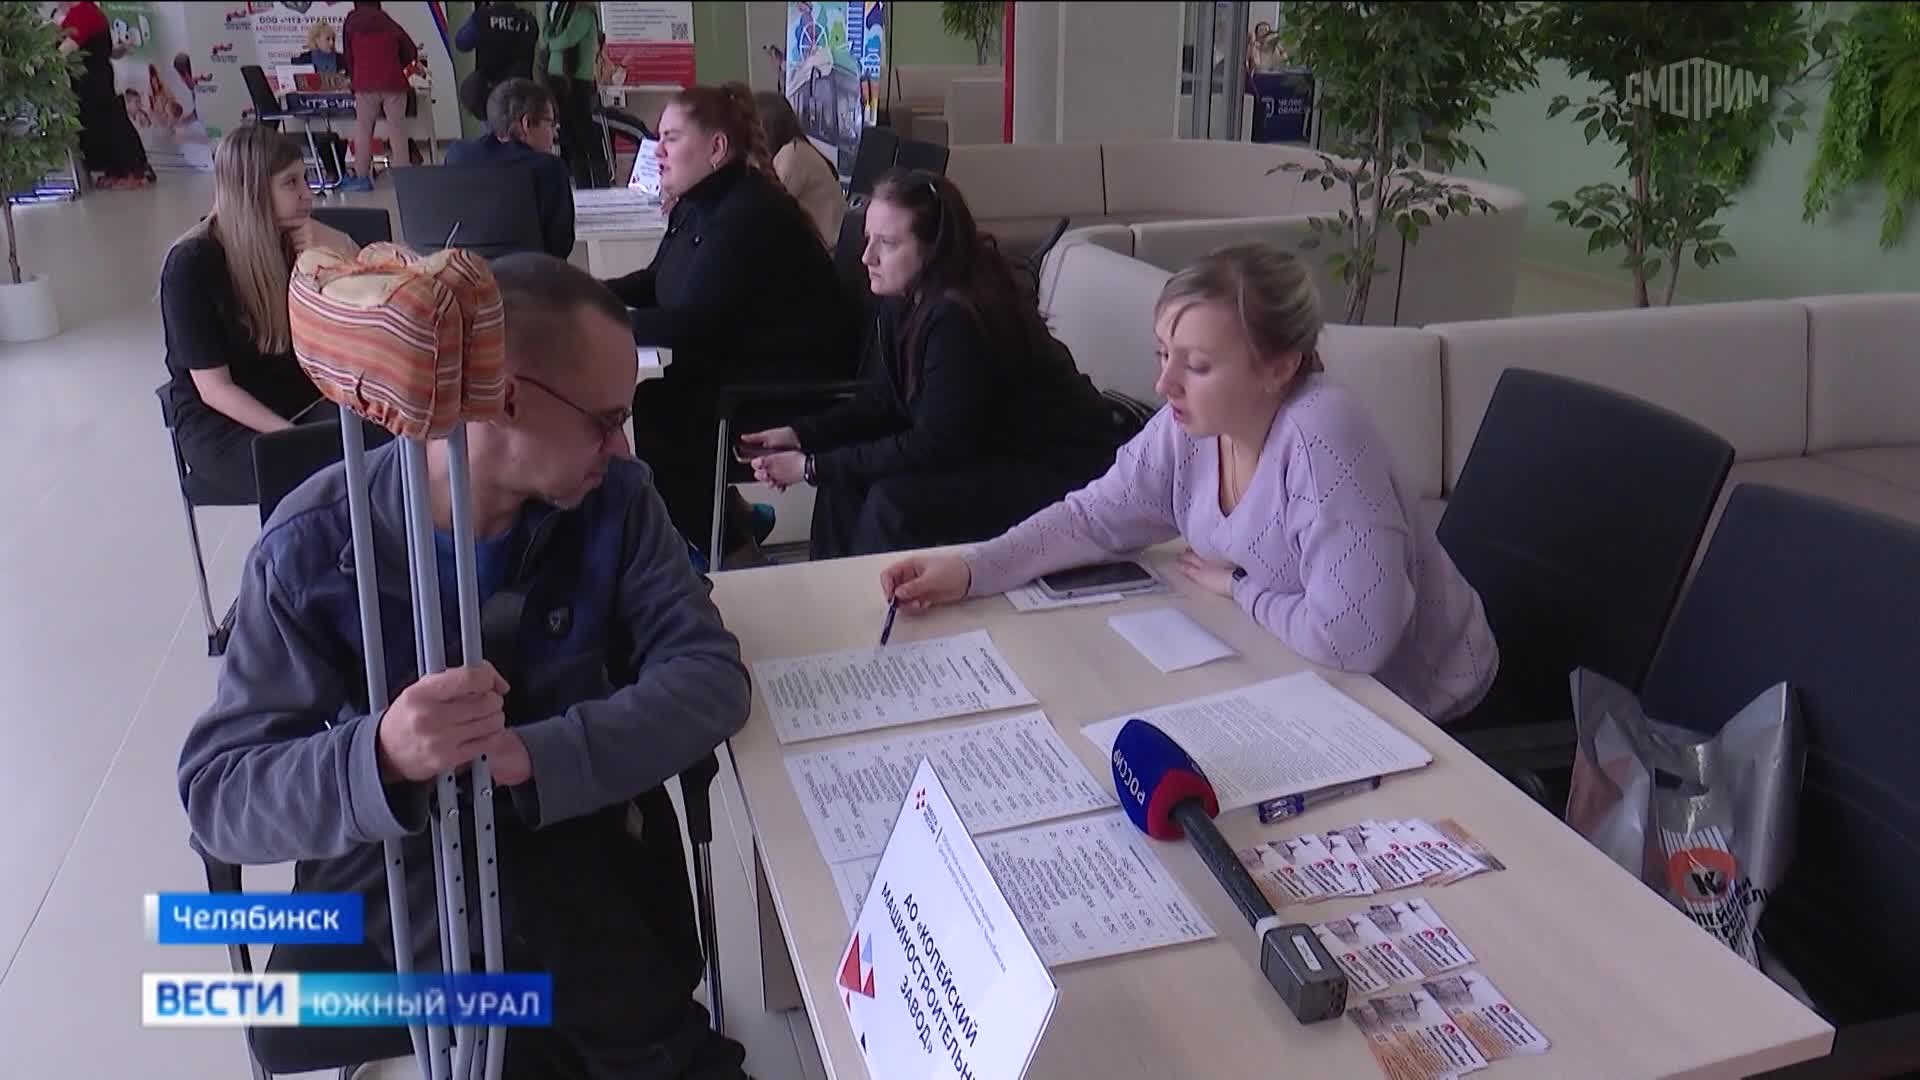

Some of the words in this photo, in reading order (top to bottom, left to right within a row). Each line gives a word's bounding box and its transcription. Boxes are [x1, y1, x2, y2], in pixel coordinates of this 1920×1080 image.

[881, 881, 976, 1080] МАШИНОСТРОИТЕЛЬН
[900, 976, 933, 1054] ЗАВОД»
[904, 894, 918, 921] АО
[917, 922, 978, 1048] «КОПЕЙСКИЙ
